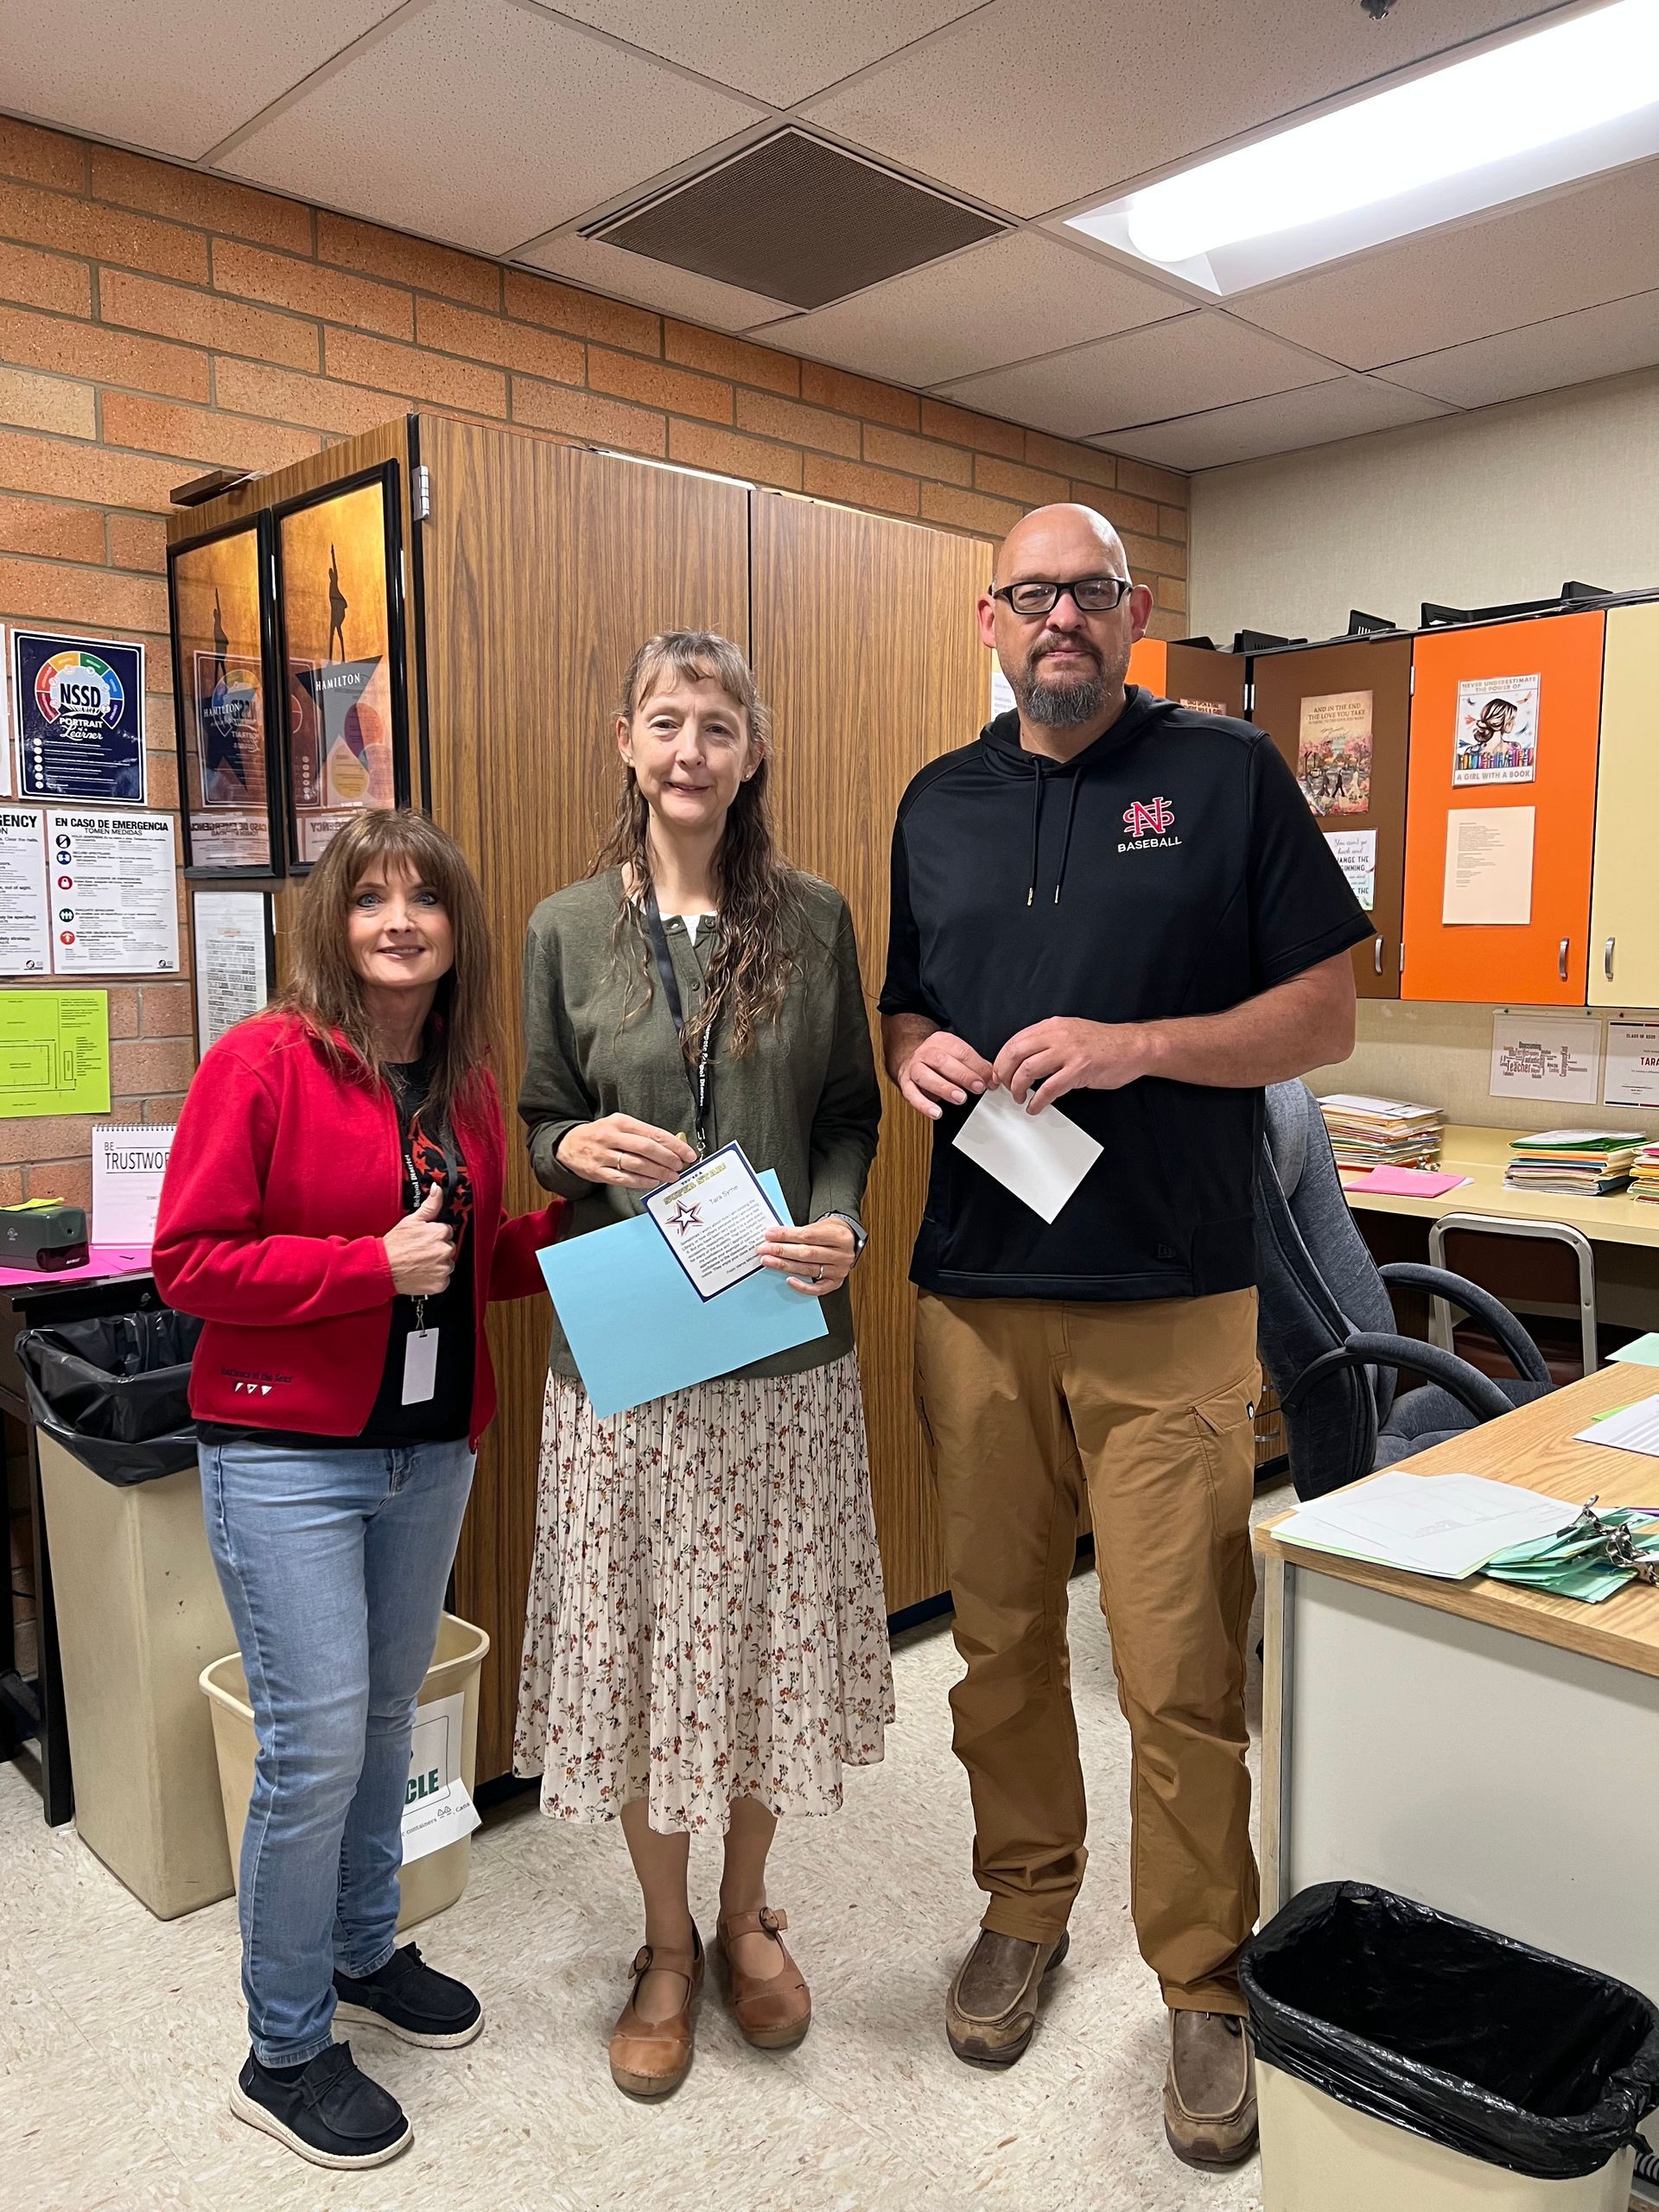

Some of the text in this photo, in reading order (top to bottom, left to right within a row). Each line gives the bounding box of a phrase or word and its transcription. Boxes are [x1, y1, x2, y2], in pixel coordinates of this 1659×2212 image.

[315, 673, 360, 691] HAMILTON
[1484, 677, 1536, 686] UNDERESTIMATE
[60, 683, 101, 708] NSSD
[203, 702, 240, 718] HAMILTON
[60, 717, 103, 728] PORTRAIT
[60, 725, 104, 741] Learner
[0, 814, 37, 828] ENCY
[55, 817, 168, 831] EN CASO DE EMERGENCIA
[1117, 836, 1183, 854] BASEBALL
[1334, 838, 1344, 848] You
[1507, 1059, 1531, 1073] Teacher
[1641, 1057, 1659, 1066] TARA
[105, 1141, 114, 1151] BE
[404, 1154, 422, 1208] School District
[664, 1163, 726, 1205] SUPER STAR!
[722, 1185, 738, 1197] Syme
[406, 1802, 470, 1834] containers Cans
